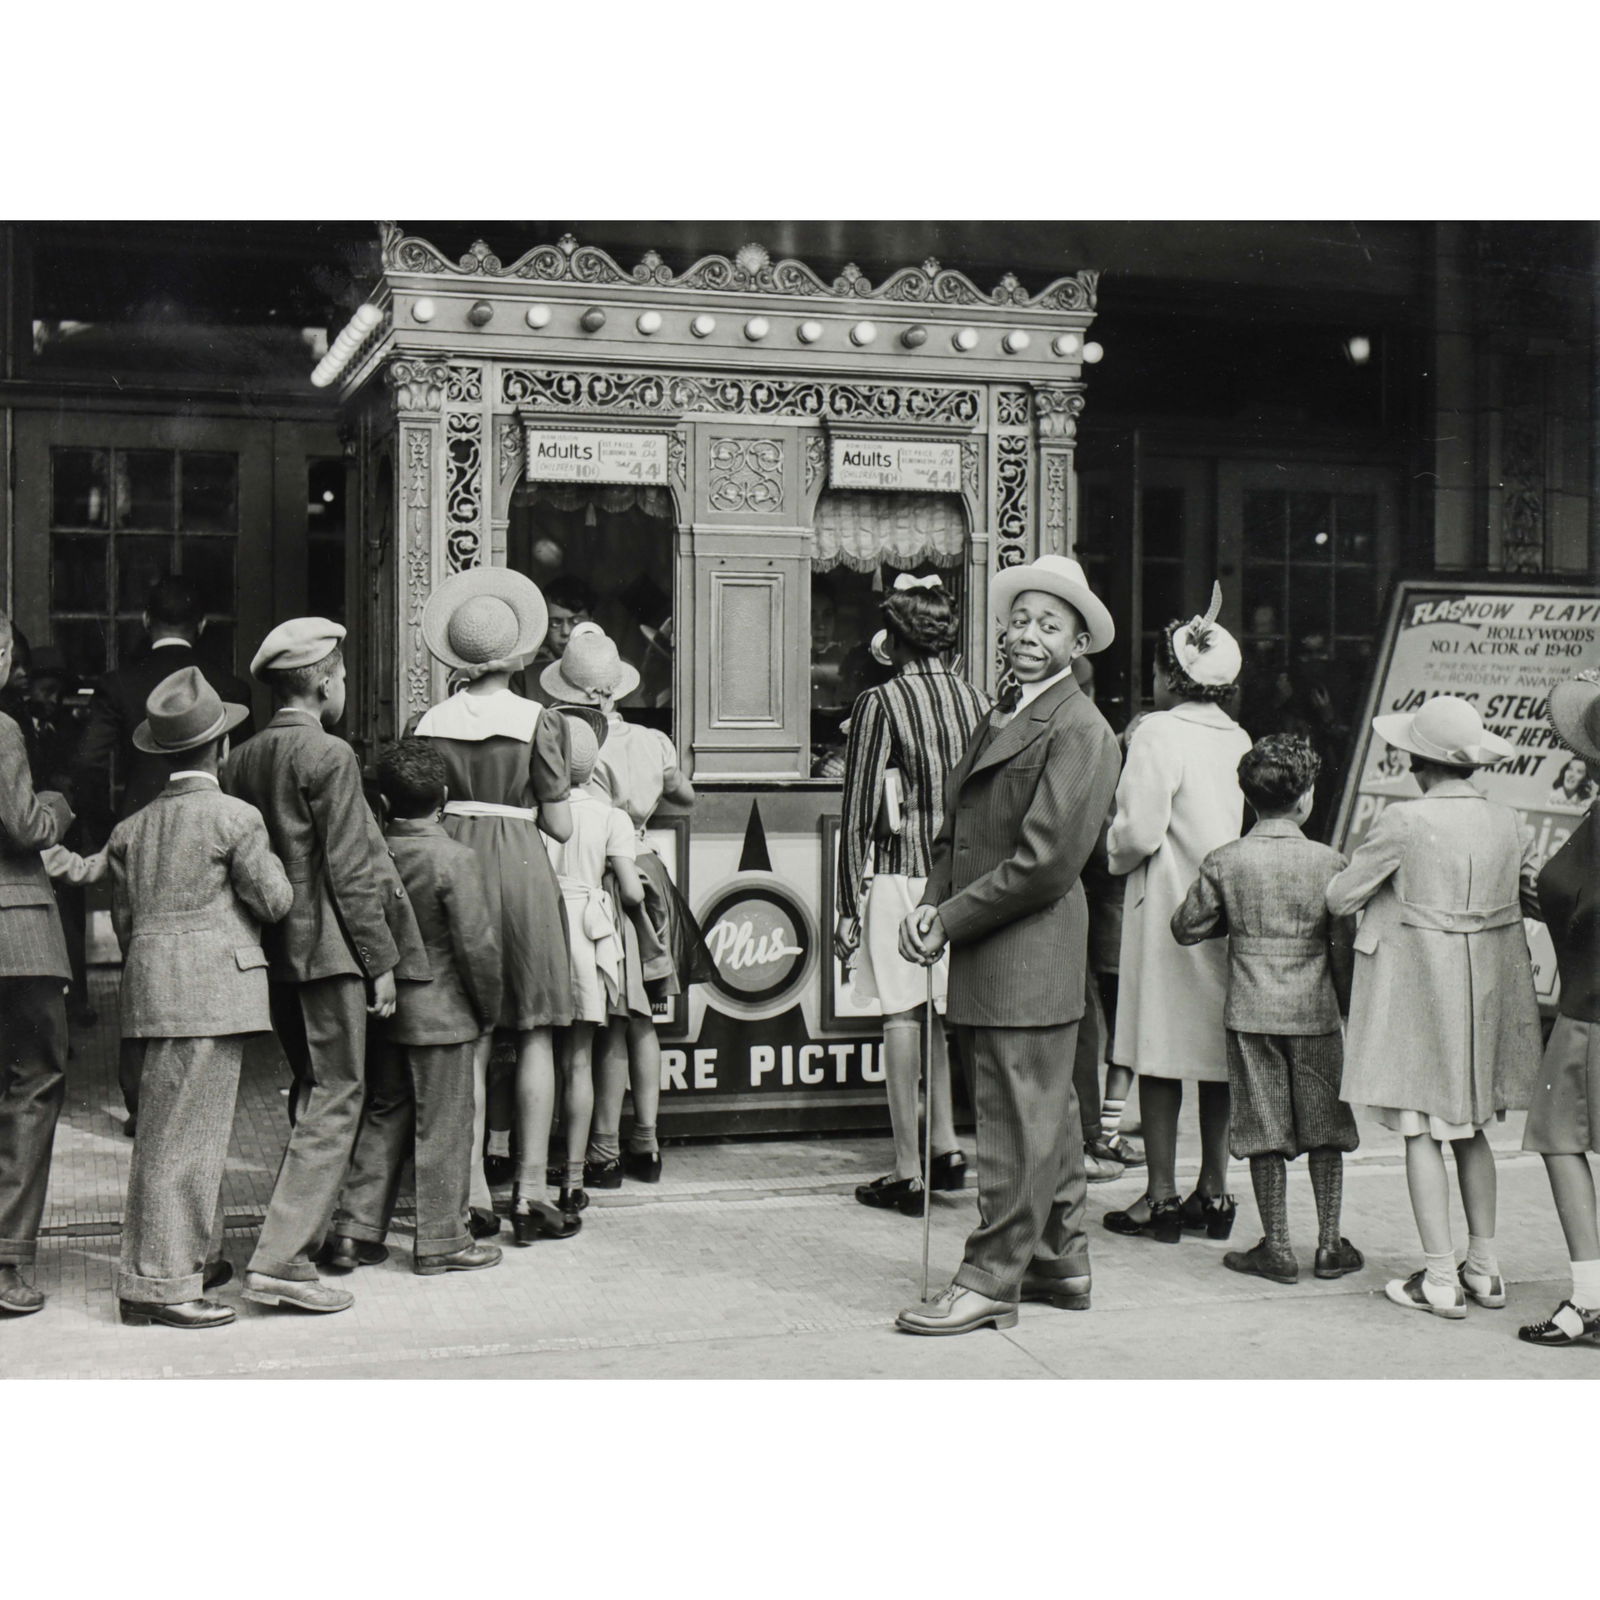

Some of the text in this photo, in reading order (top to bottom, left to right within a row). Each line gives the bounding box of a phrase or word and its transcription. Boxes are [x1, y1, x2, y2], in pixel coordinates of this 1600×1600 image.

[537, 442, 593, 460] Adults
[842, 451, 892, 468] Adults
[1462, 602, 1514, 619] NOW
[1463, 641, 1520, 656] ACTOR
[1524, 643, 1540, 656] of
[1544, 643, 1583, 657] 1940
[1448, 671, 1511, 686] ACADEMY
[704, 919, 803, 970] Plus
